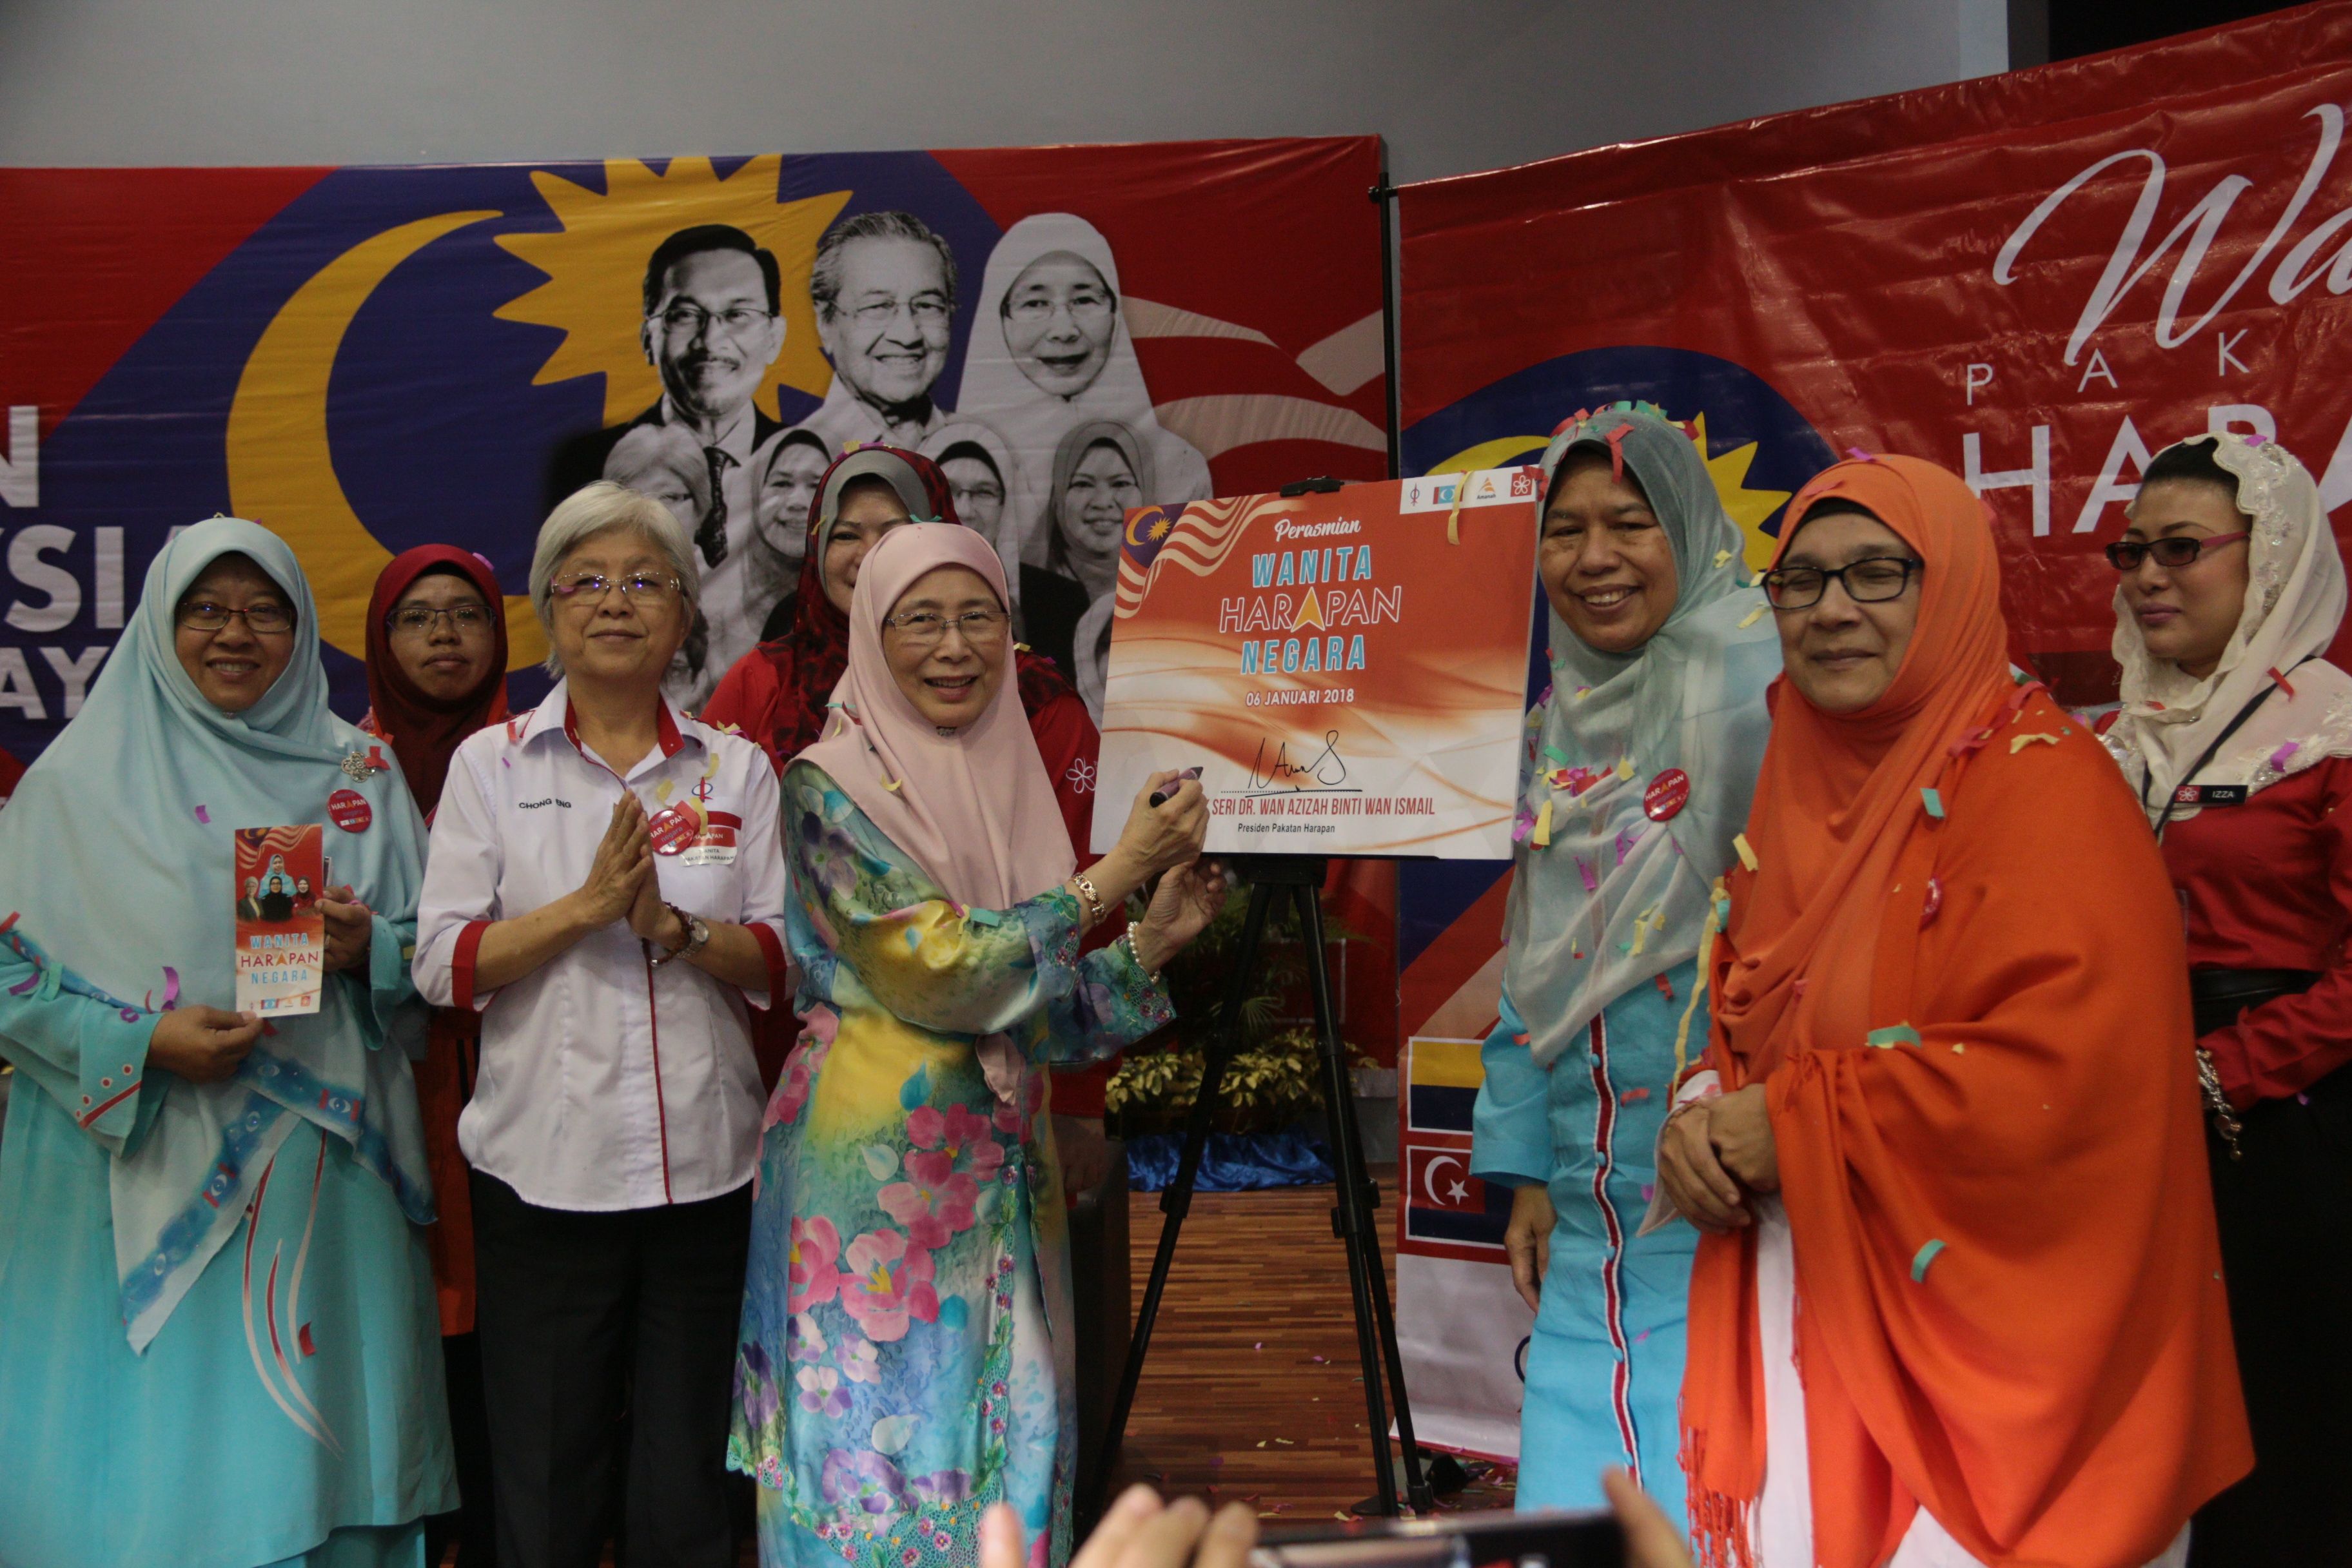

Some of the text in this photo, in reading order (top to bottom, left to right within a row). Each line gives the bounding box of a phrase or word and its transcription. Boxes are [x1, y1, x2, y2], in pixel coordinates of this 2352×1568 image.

[1274, 516, 1361, 542] Perasmian
[1252, 545, 1371, 588] WANITA
[1219, 585, 1402, 633] HARAPAN
[1240, 634, 1366, 675] NEGARA
[1246, 688, 1355, 707] 06 JANUARI 2018
[518, 798, 572, 808] CHONG ENG
[1212, 799, 1236, 816] SERI
[1239, 799, 1256, 815] DR.
[1260, 799, 1285, 815] WAN
[1288, 799, 1328, 815] AZIZAH
[1331, 798, 1362, 815] BINTI
[1365, 798, 1391, 815] WAN
[1395, 798, 1435, 815] ISMAIL
[1237, 823, 1335, 834] Presiden Pakatan Harapan
[250, 932, 308, 949] WANITA
[240, 951, 319, 968] HARAPAN
[251, 969, 308, 984] NEGARA
